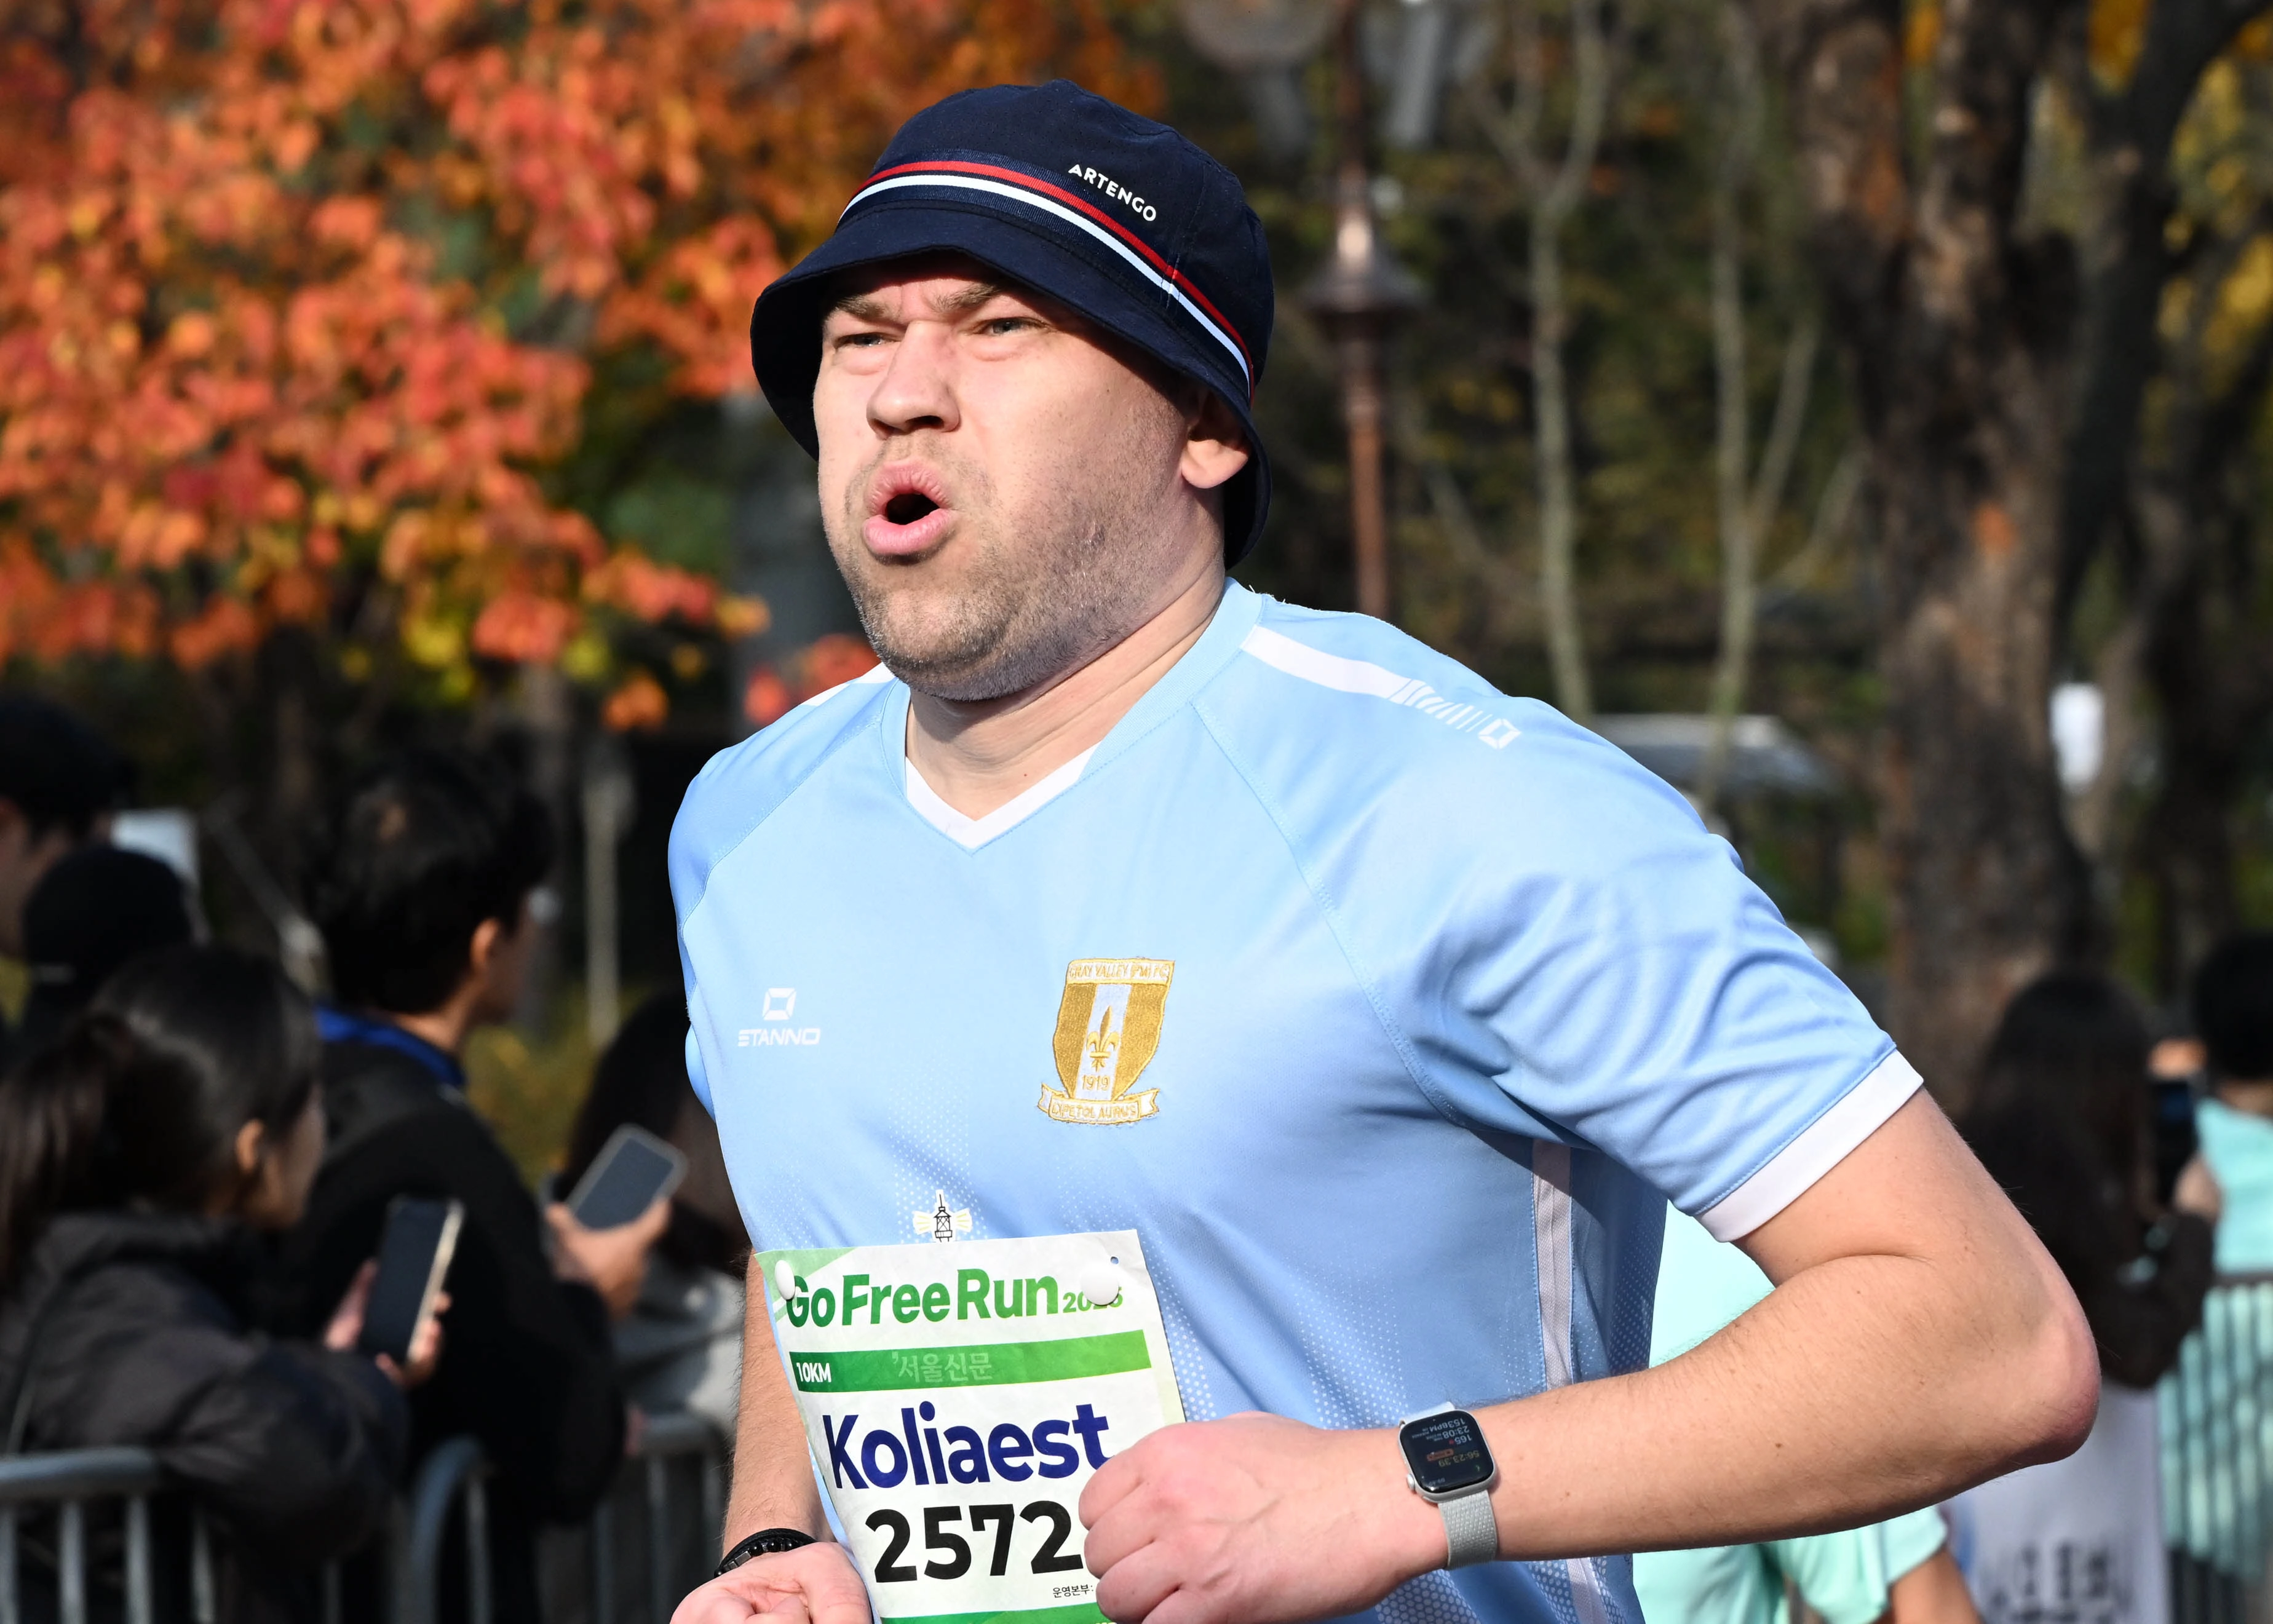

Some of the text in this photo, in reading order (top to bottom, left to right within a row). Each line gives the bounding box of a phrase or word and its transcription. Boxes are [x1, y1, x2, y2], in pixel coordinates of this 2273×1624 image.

[1068, 164, 1157, 221] ARTENGO
[1095, 964, 1129, 978] VALLEY
[738, 1028, 821, 1047] STANNO
[1081, 1075, 1110, 1091] 1919
[796, 1362, 831, 1383] 10KM
[1442, 1425, 1470, 1439] 23:08
[1454, 1434, 1472, 1445] 165
[822, 1401, 1114, 1490] Koliaest
[865, 1500, 1084, 1583] 2572
